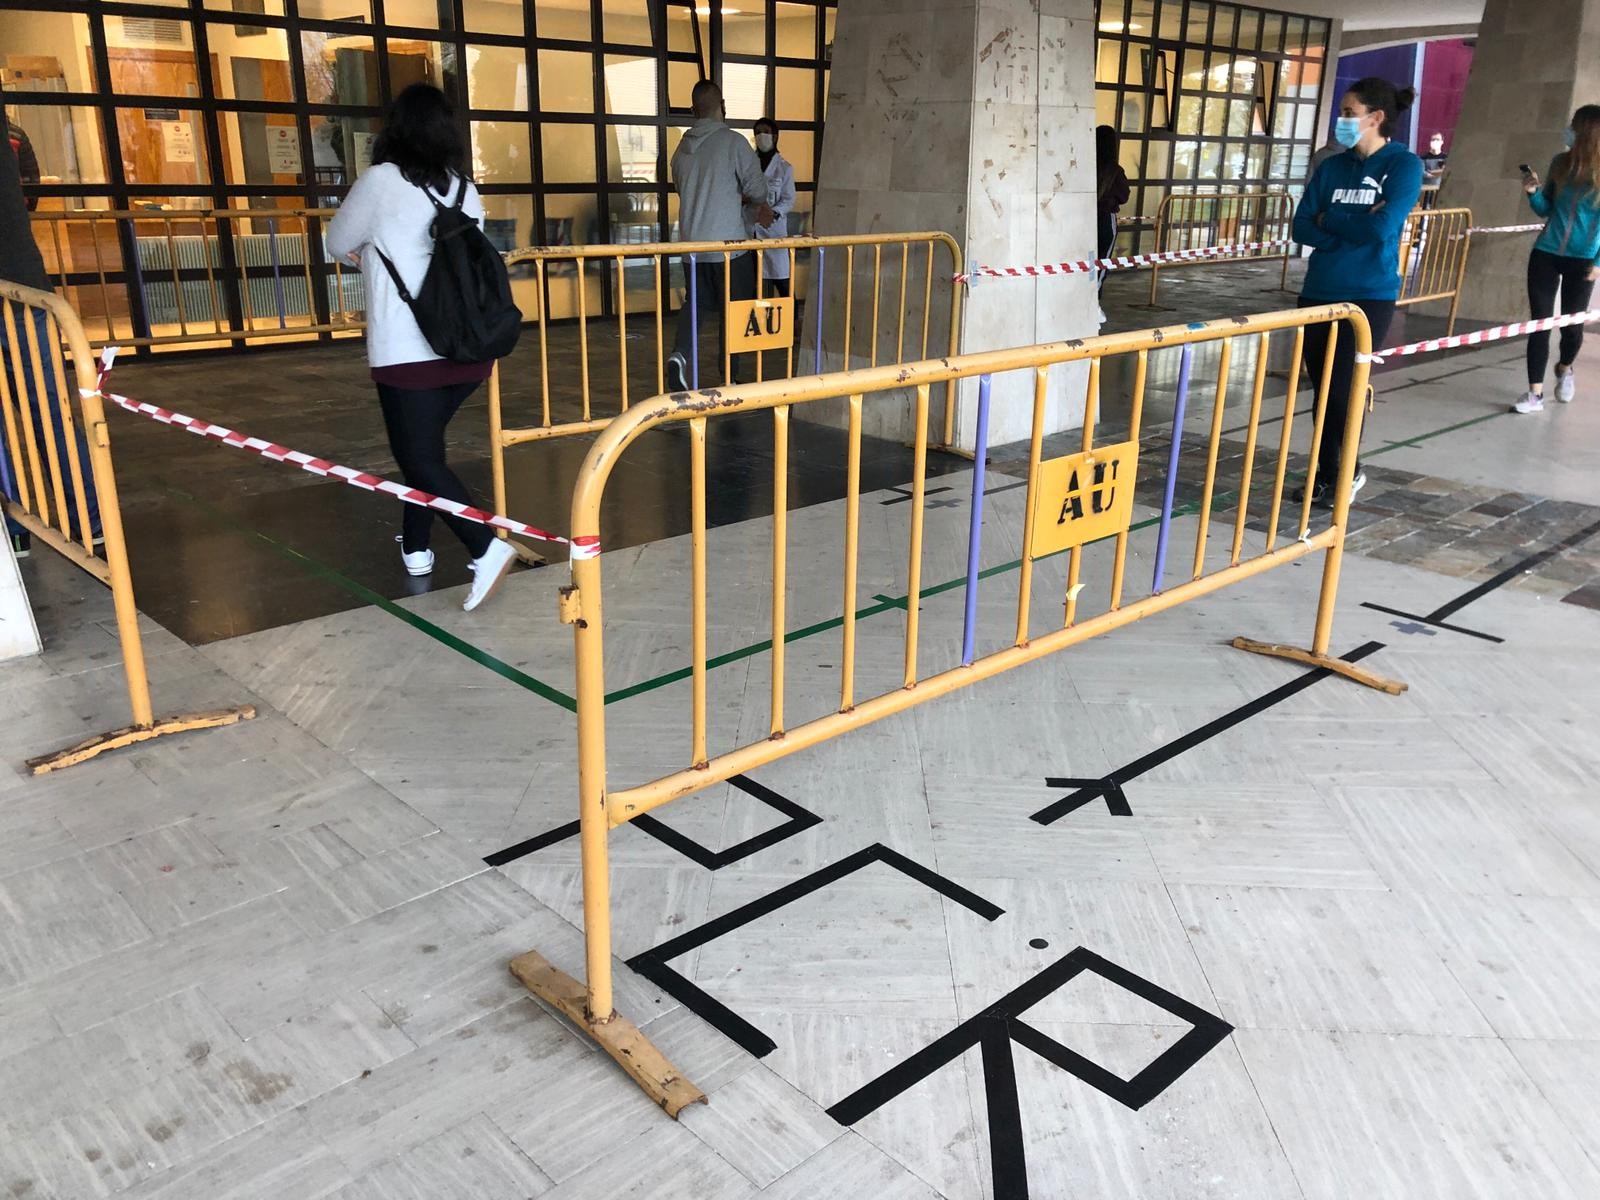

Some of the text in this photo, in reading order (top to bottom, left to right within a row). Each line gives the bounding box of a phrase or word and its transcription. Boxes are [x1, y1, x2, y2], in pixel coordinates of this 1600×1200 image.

[1331, 188, 1376, 205] PUMA
[744, 306, 782, 337] AU
[1057, 460, 1119, 524] AU
